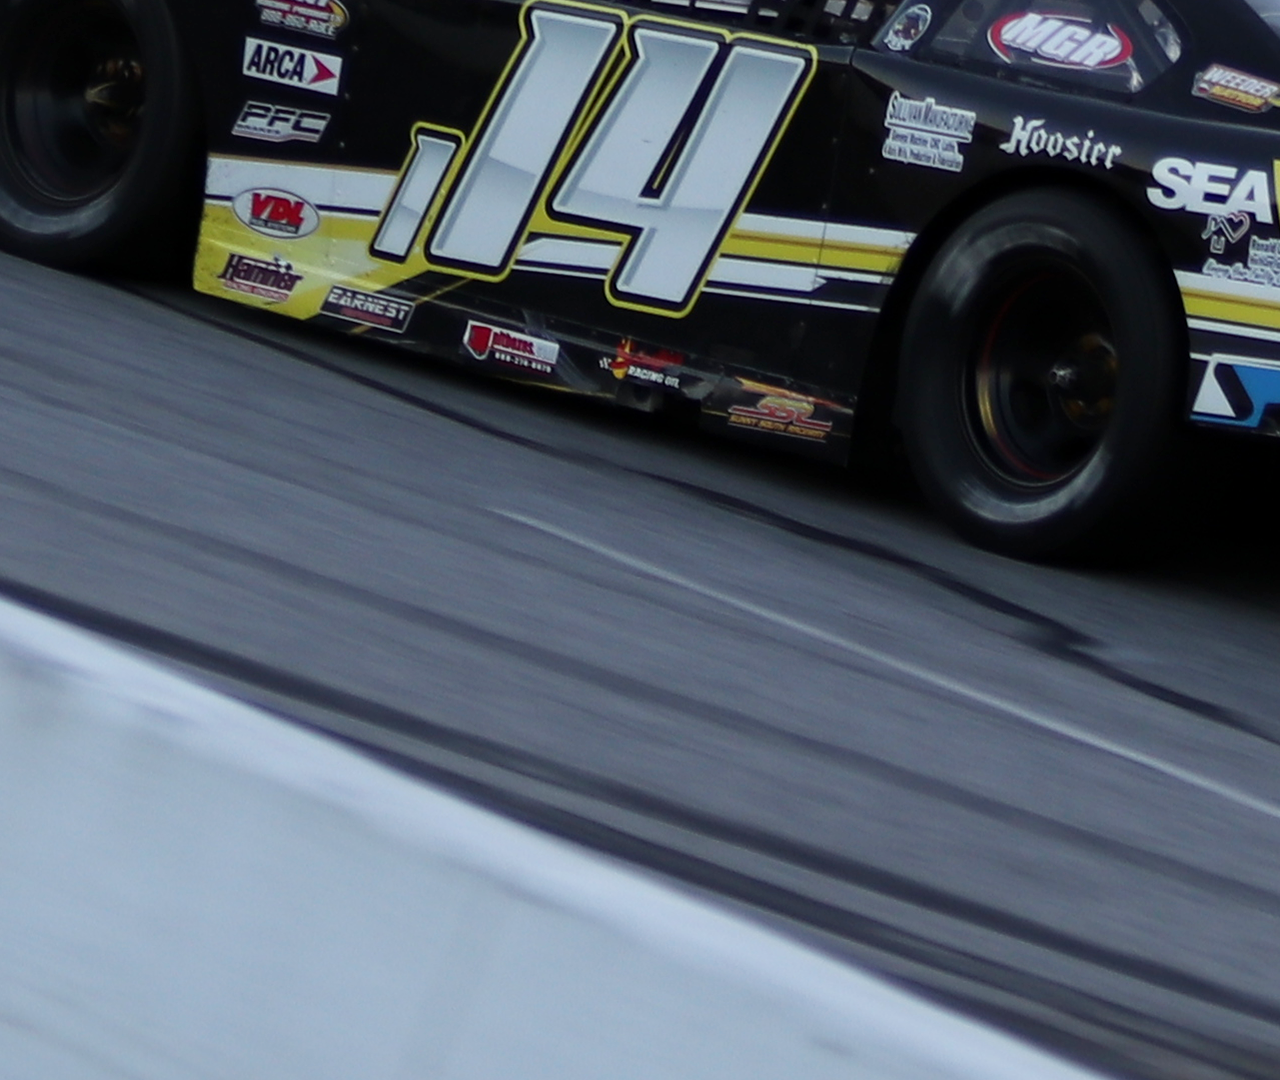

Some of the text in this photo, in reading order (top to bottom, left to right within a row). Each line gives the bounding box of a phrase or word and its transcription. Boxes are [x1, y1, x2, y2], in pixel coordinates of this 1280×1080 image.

[1001, 12, 1121, 67] MGR
[246, 43, 307, 83] ARCA
[1204, 65, 1280, 100] WEEDER
[239, 103, 330, 135] PFC
[999, 115, 1122, 170] Hoosier
[1146, 156, 1274, 225] SEA
[250, 192, 305, 227] VDL
[326, 287, 412, 320] EARNEST
[627, 365, 681, 389] RACING OIL
